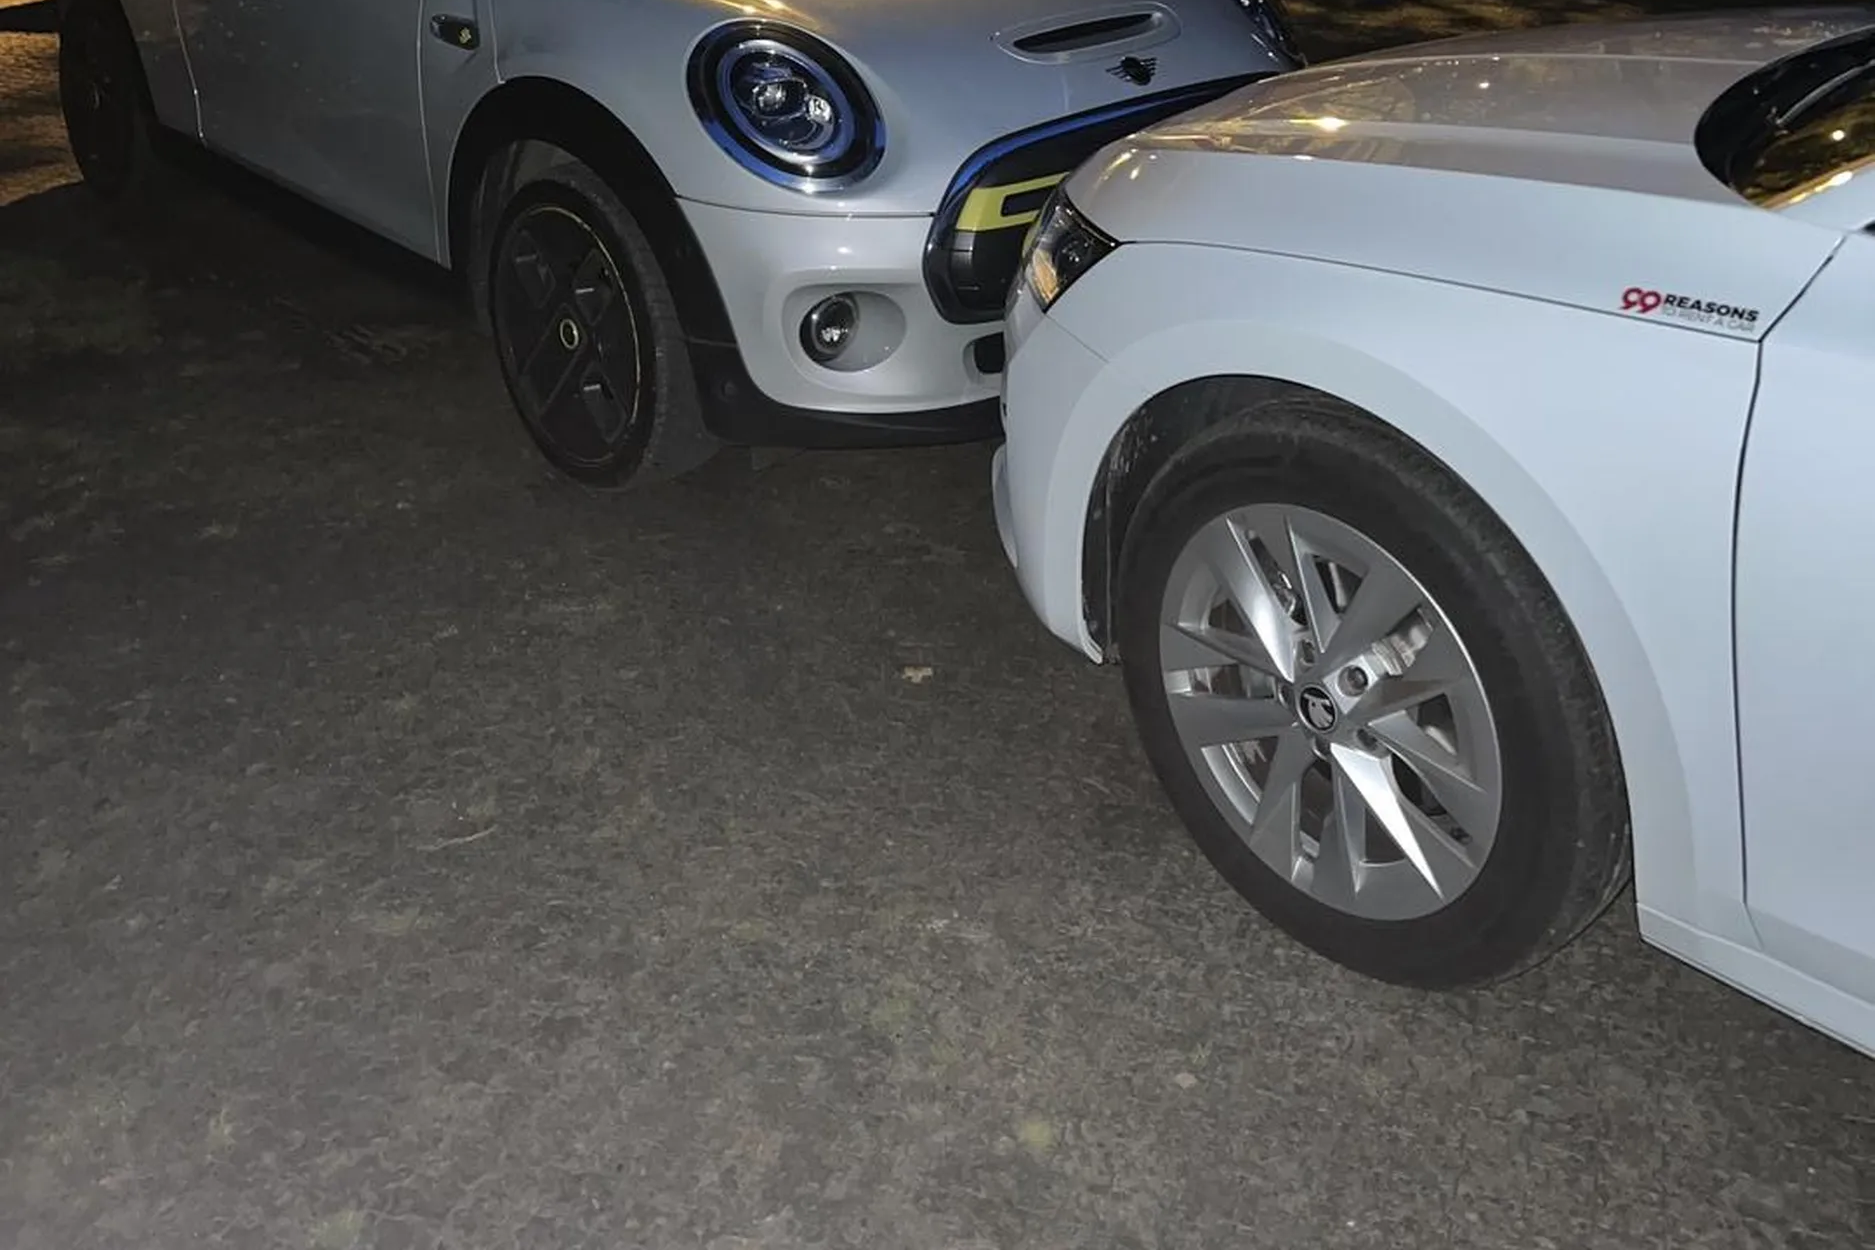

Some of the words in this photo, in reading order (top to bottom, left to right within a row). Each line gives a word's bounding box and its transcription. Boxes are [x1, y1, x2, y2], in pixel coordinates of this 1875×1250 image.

[1620, 286, 1661, 314] 99
[1664, 293, 1760, 322] REASONS
[1677, 308, 1710, 323] RENT
[1713, 317, 1725, 326] A
[1727, 319, 1756, 332] CAR
